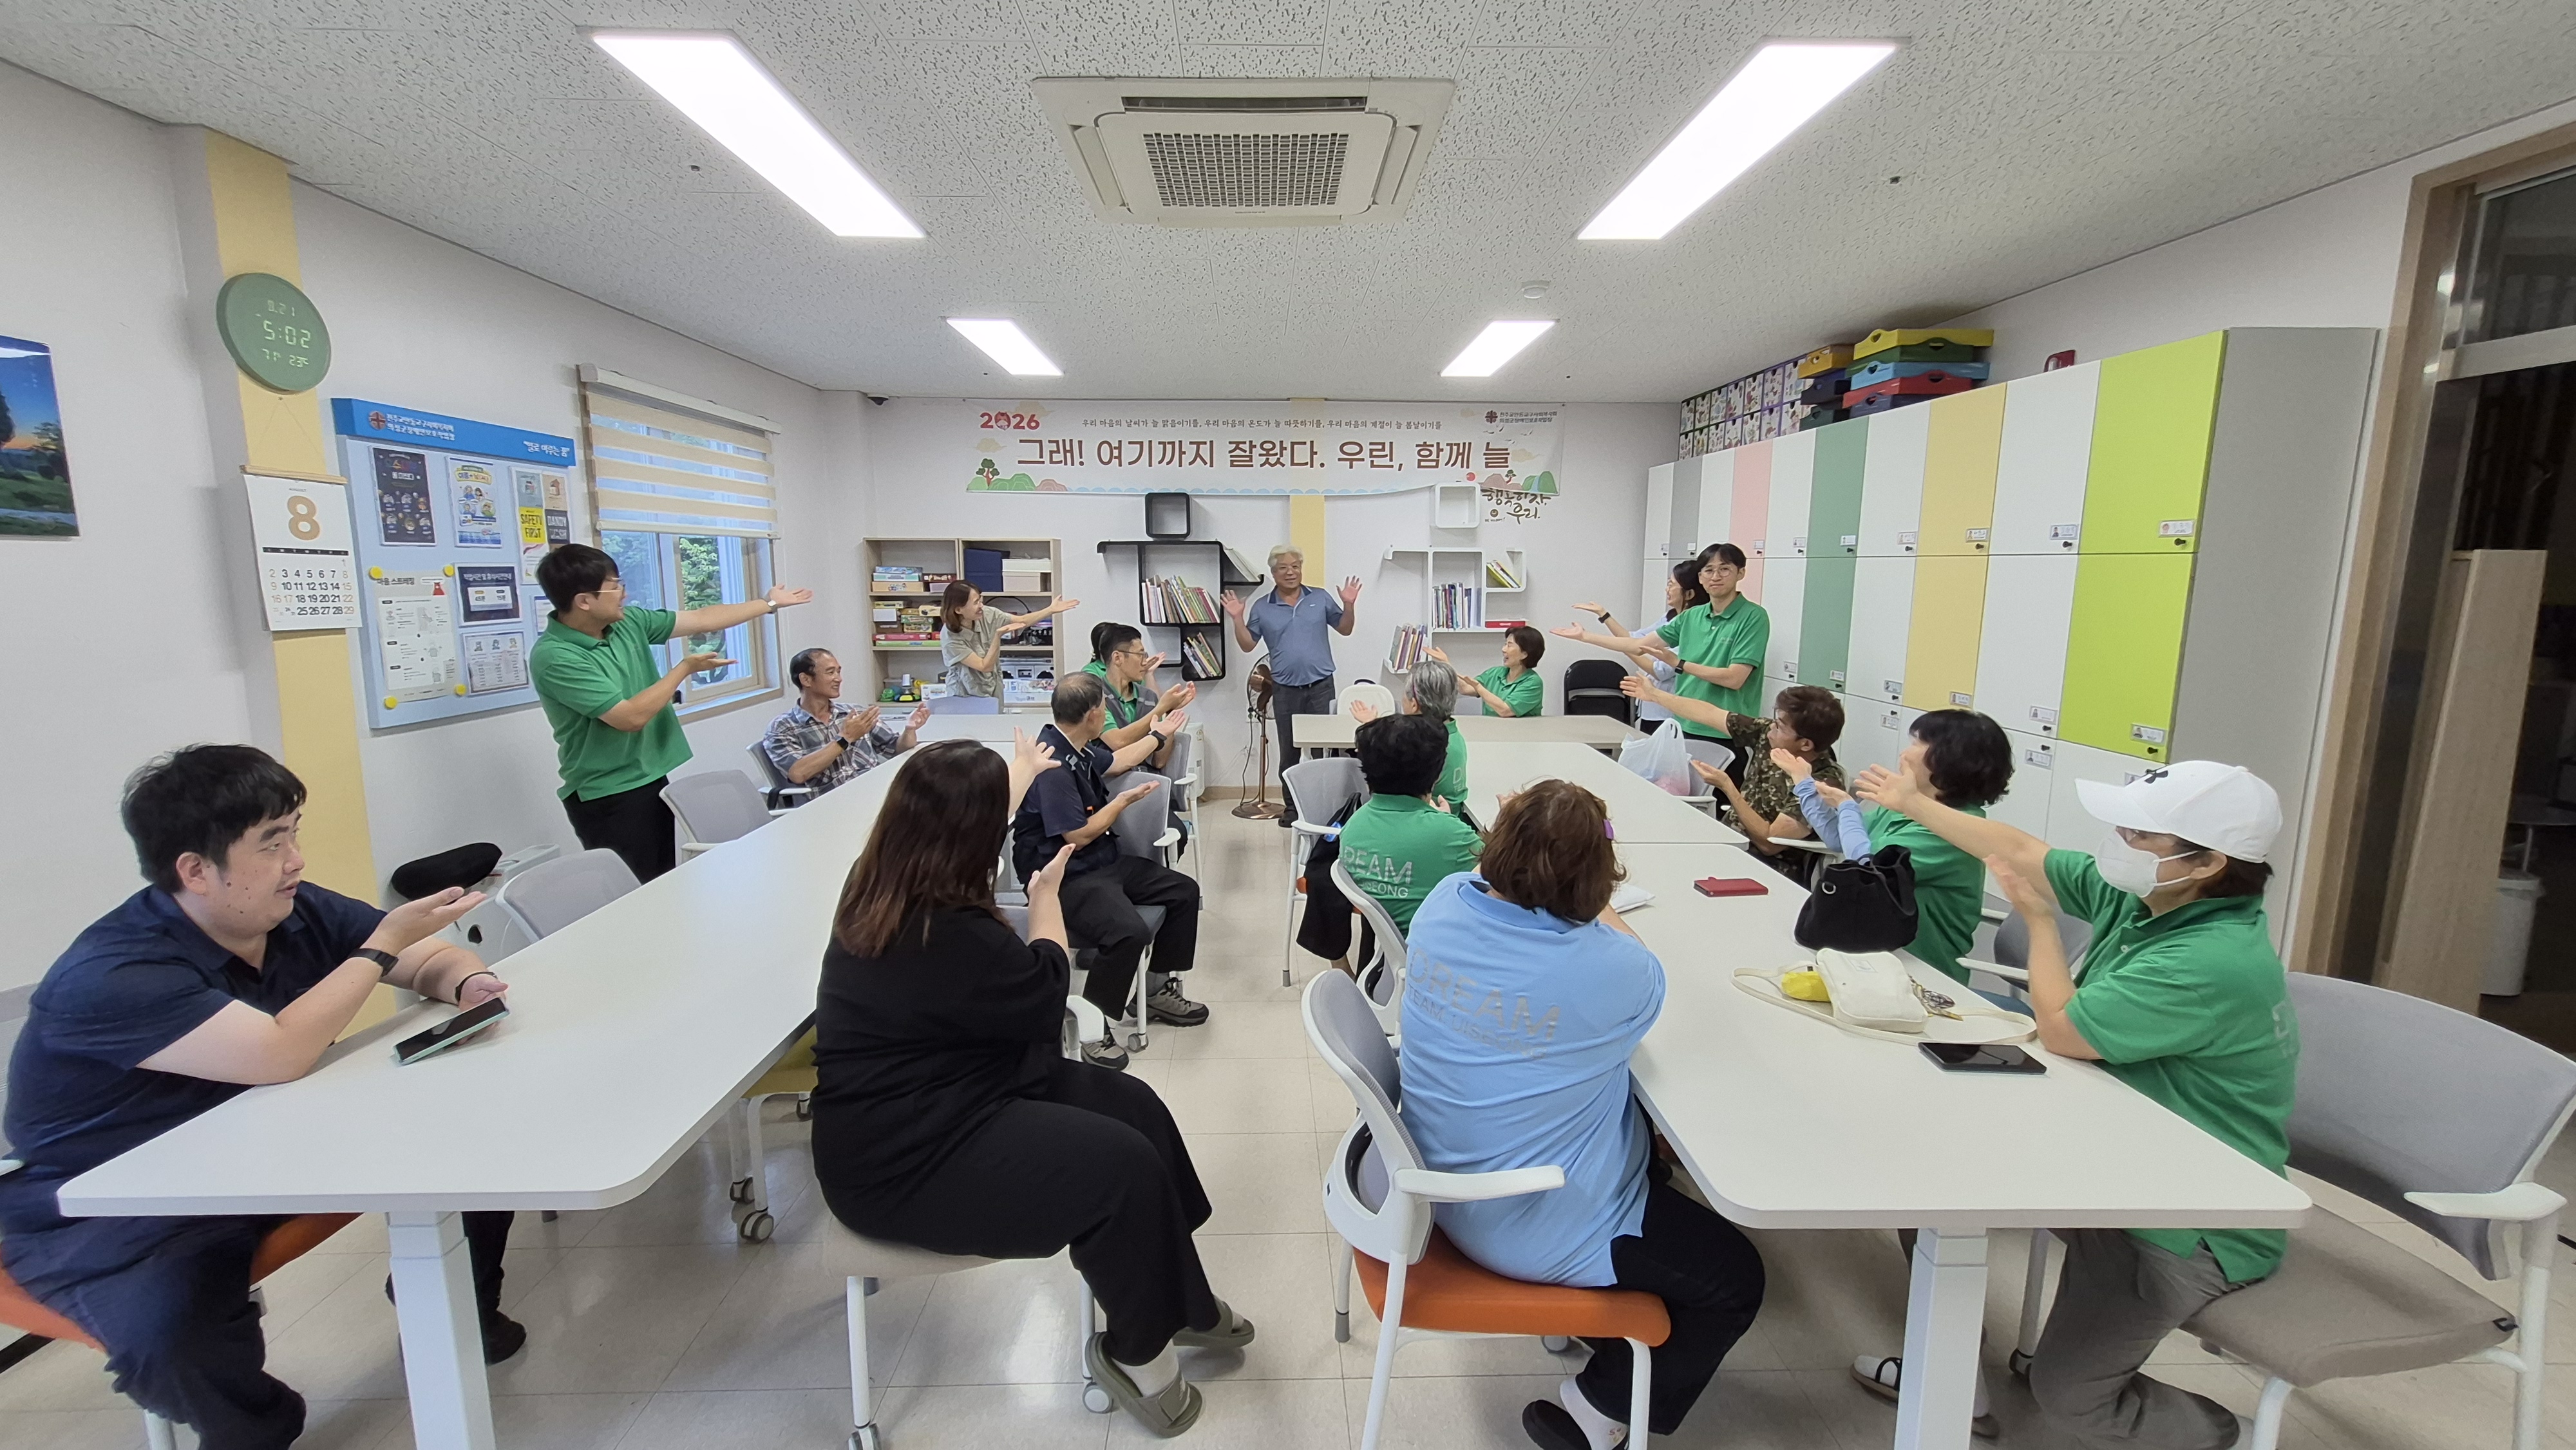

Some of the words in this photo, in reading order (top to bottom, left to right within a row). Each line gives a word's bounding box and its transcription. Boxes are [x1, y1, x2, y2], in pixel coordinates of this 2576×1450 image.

[263, 320, 311, 349] 5:02
[980, 411, 1041, 431] 2026
[1100, 419, 1122, 428] 마음의
[1126, 419, 1148, 428] 날씨가
[1151, 419, 1159, 428] 늘
[1162, 419, 1202, 428] 맑음이기를,
[1205, 419, 1219, 428] 우리
[1222, 420, 1245, 428] 마음의
[1248, 420, 1271, 428] 온도가
[1274, 419, 1280, 428] 늘
[1285, 419, 1325, 429] 따뜻하기를,
[1345, 420, 1367, 429] 마음의
[1370, 421, 1392, 429] 계절이
[1396, 421, 1403, 429] 늘
[1406, 421, 1442, 430] 봄날이기를
[1018, 439, 1084, 467] 그래!
[1097, 439, 1214, 467] 여기까지
[1227, 440, 1325, 469] 잘왔다.
[1337, 442, 1403, 472] 우린,
[1416, 442, 1472, 469] 함께
[1482, 442, 1511, 469] 늘
[287, 495, 321, 541] 8
[520, 513, 543, 527] SAFETY
[1506, 502, 1540, 525] 우리.
[342, 558, 346, 567] 1
[269, 569, 276, 578] 2
[281, 569, 289, 578] 3
[294, 569, 301, 578] 4
[306, 569, 313, 578] 5
[318, 569, 325, 578] 6
[330, 570, 336, 578] 7
[343, 570, 348, 578] 8
[270, 581, 277, 590] 9
[281, 582, 292, 590] 10
[294, 582, 304, 590] 11
[306, 582, 317, 591] 12
[317, 582, 328, 591] 13
[330, 582, 340, 590] 14
[342, 582, 352, 590] 15
[272, 595, 282, 603] 16
[295, 594, 307, 603] 18
[307, 594, 318, 603] 19
[319, 594, 330, 603] 20
[330, 594, 341, 603] 21
[343, 594, 354, 603] 22
[297, 607, 308, 616] 25
[308, 607, 320, 616] 26
[321, 607, 330, 615] 27
[332, 606, 343, 615] 28
[344, 606, 354, 614] 29
[1408, 948, 1561, 1040] DREAM
